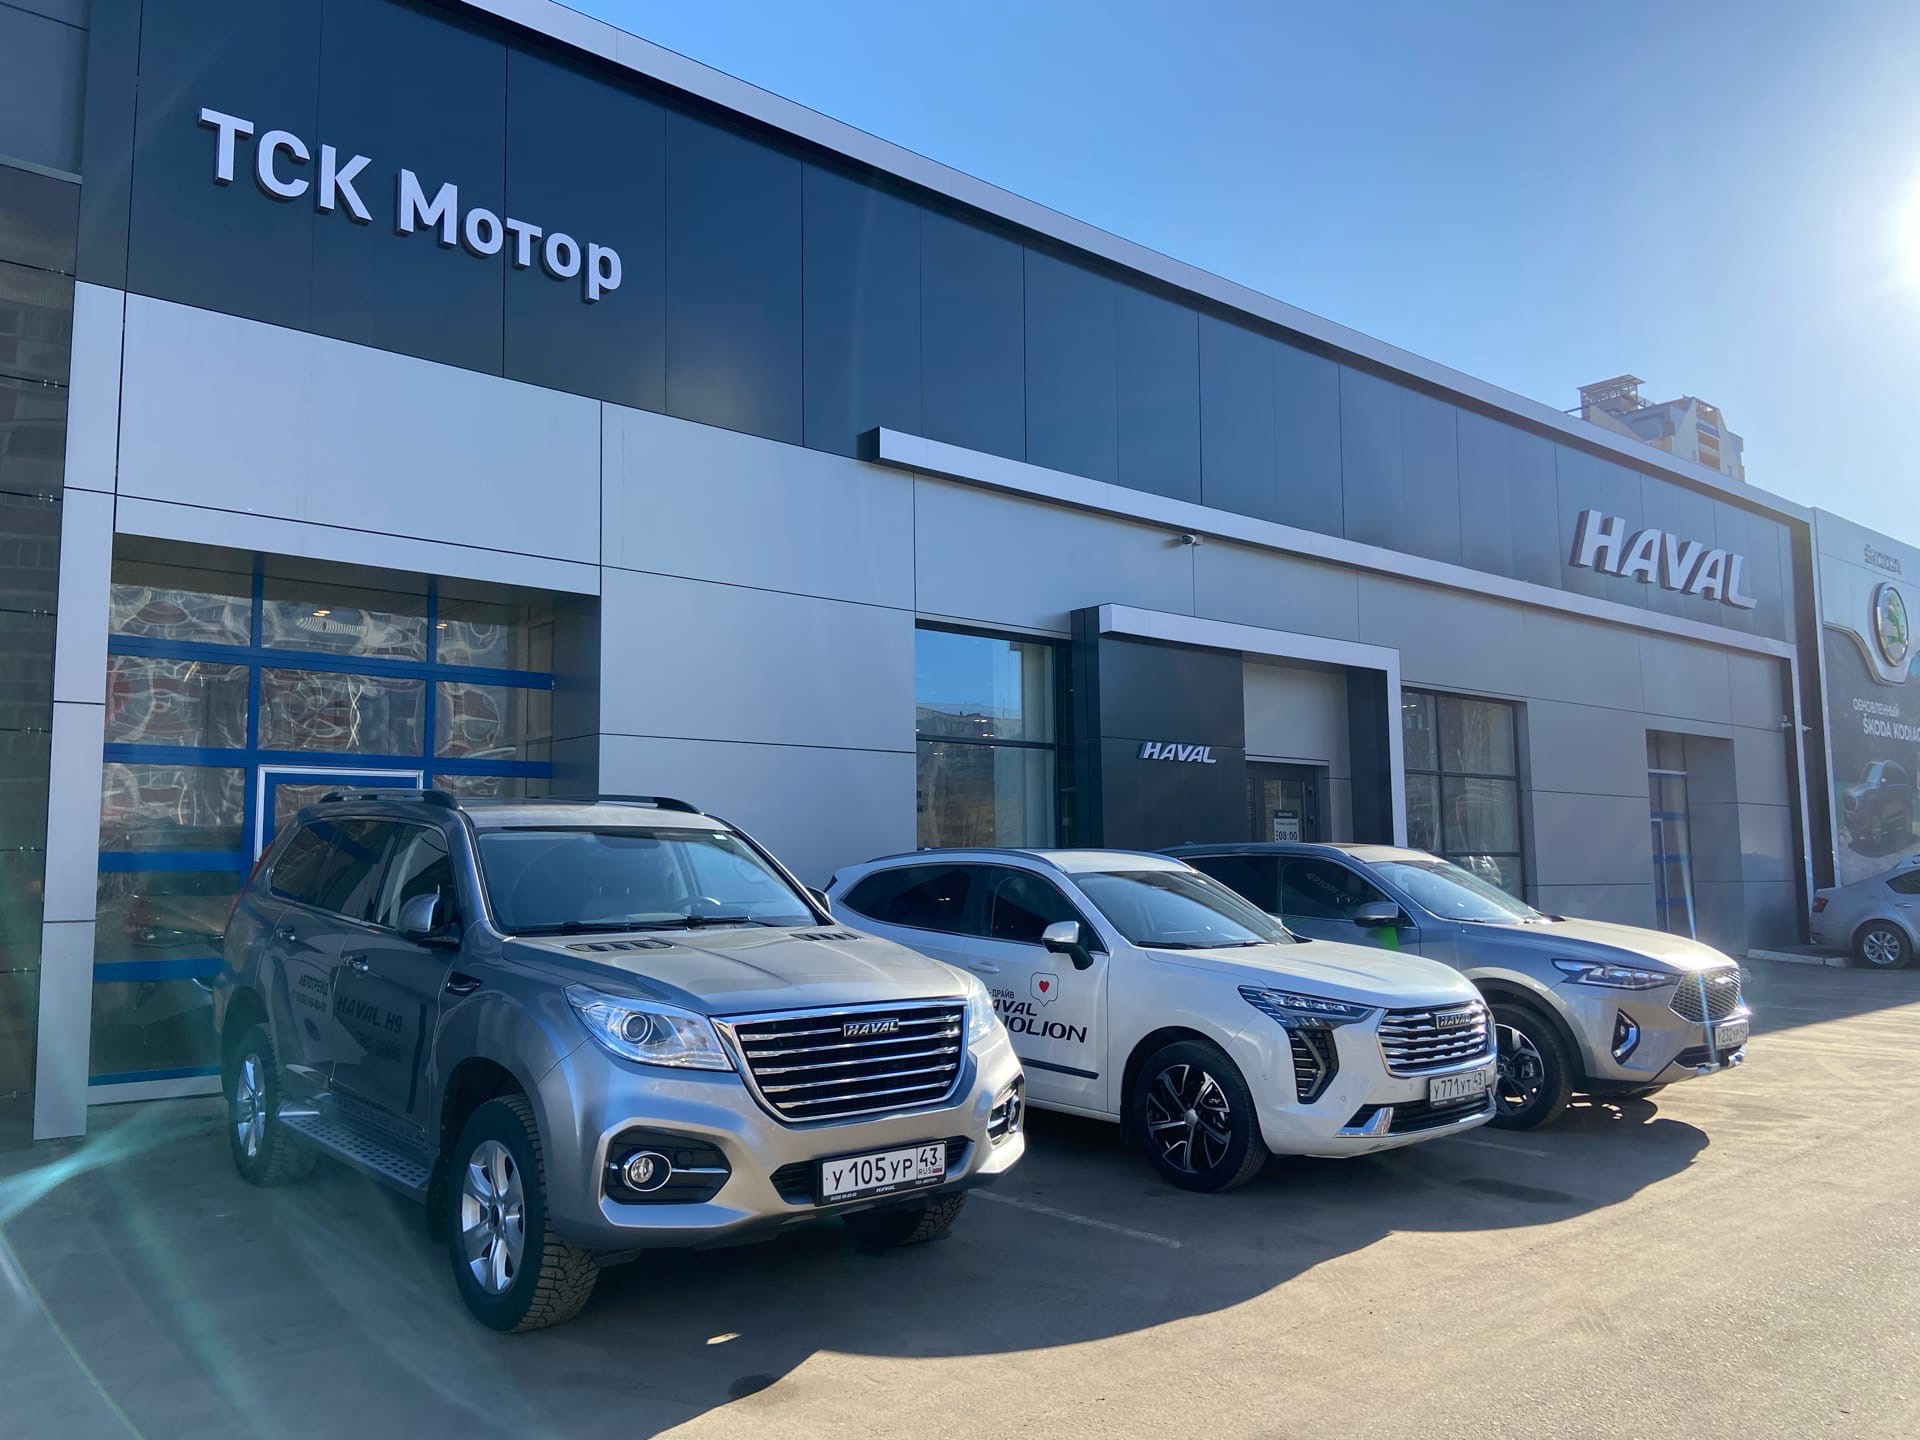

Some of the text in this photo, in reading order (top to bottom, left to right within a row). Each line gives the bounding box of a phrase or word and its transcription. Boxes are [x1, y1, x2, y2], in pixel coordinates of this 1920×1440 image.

[199, 107, 622, 303] ТСК Мотор
[1571, 508, 1759, 610] HAVAL
[1862, 713, 1893, 738] ŠKODA
[1140, 741, 1217, 764] HAVAL
[336, 995, 380, 1027] HAVAL
[385, 1011, 403, 1035] H9
[993, 998, 1037, 1017] AVAL
[847, 1019, 899, 1036] HAVAL
[919, 1146, 938, 1168] 43
[918, 1167, 932, 1176] RUS
